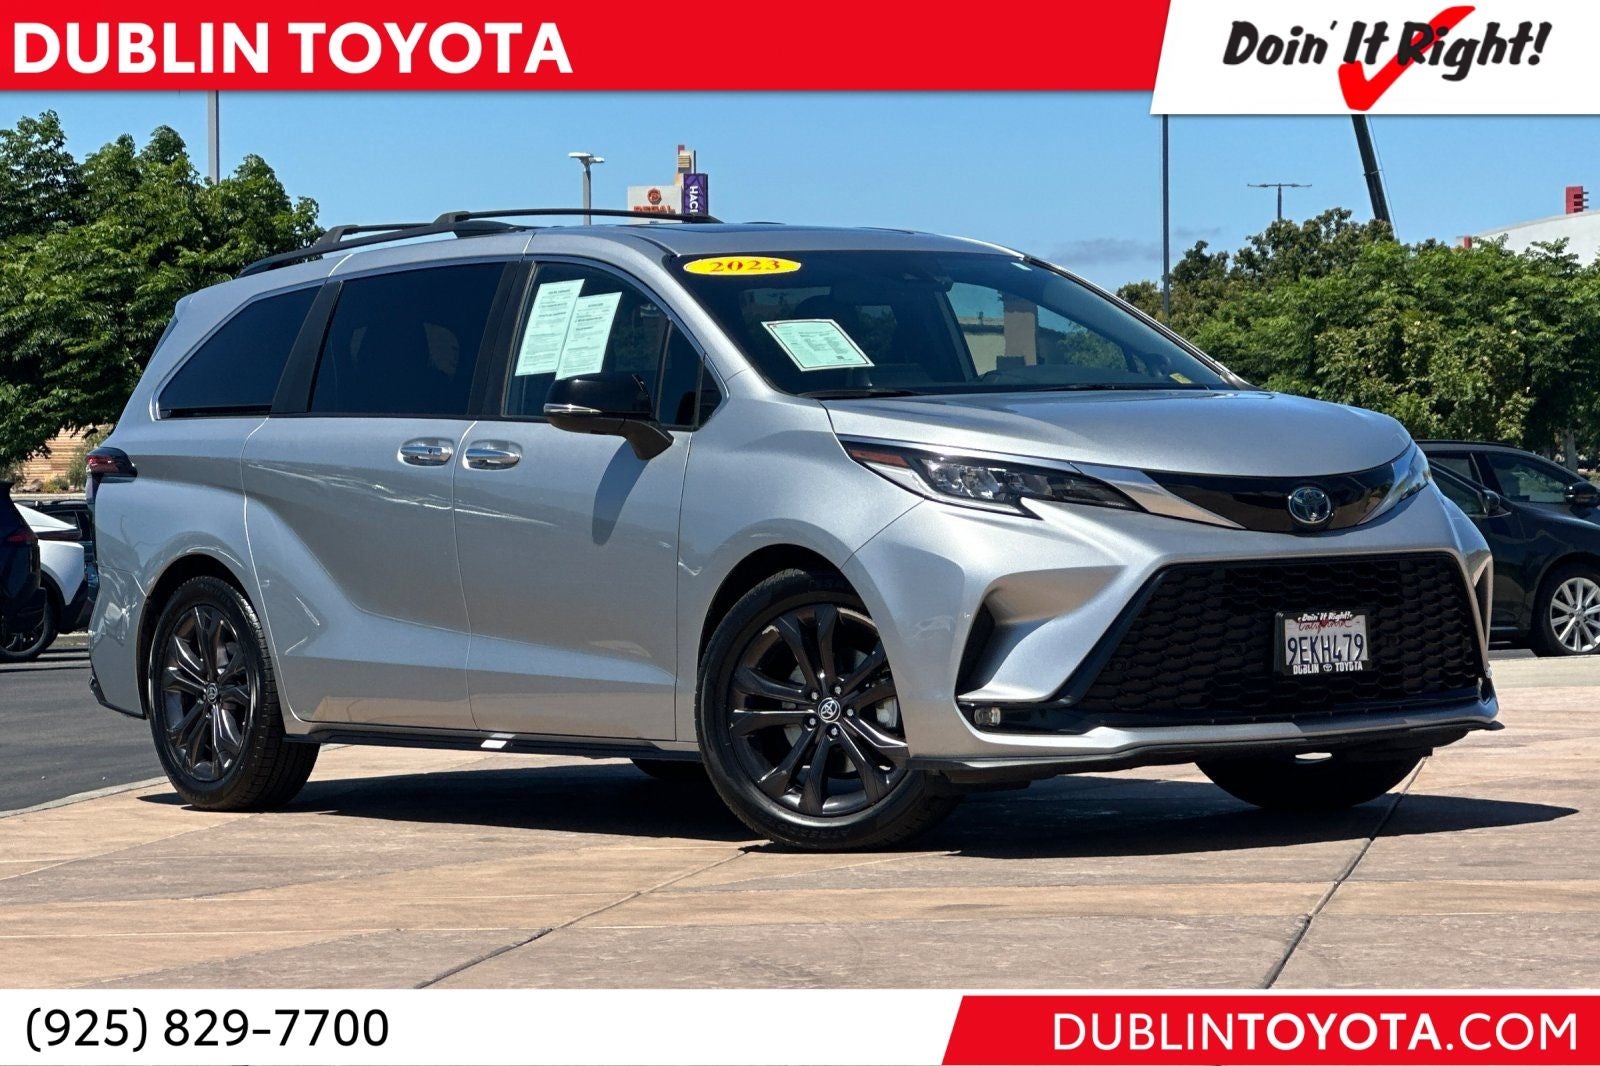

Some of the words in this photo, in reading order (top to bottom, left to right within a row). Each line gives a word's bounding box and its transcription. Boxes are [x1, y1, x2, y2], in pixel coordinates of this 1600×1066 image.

[708, 259, 781, 273] 2023
[1287, 633, 1364, 666] 9EKH479
[1292, 663, 1320, 675] DUBLIN
[1334, 661, 1364, 672] TOYOTA
